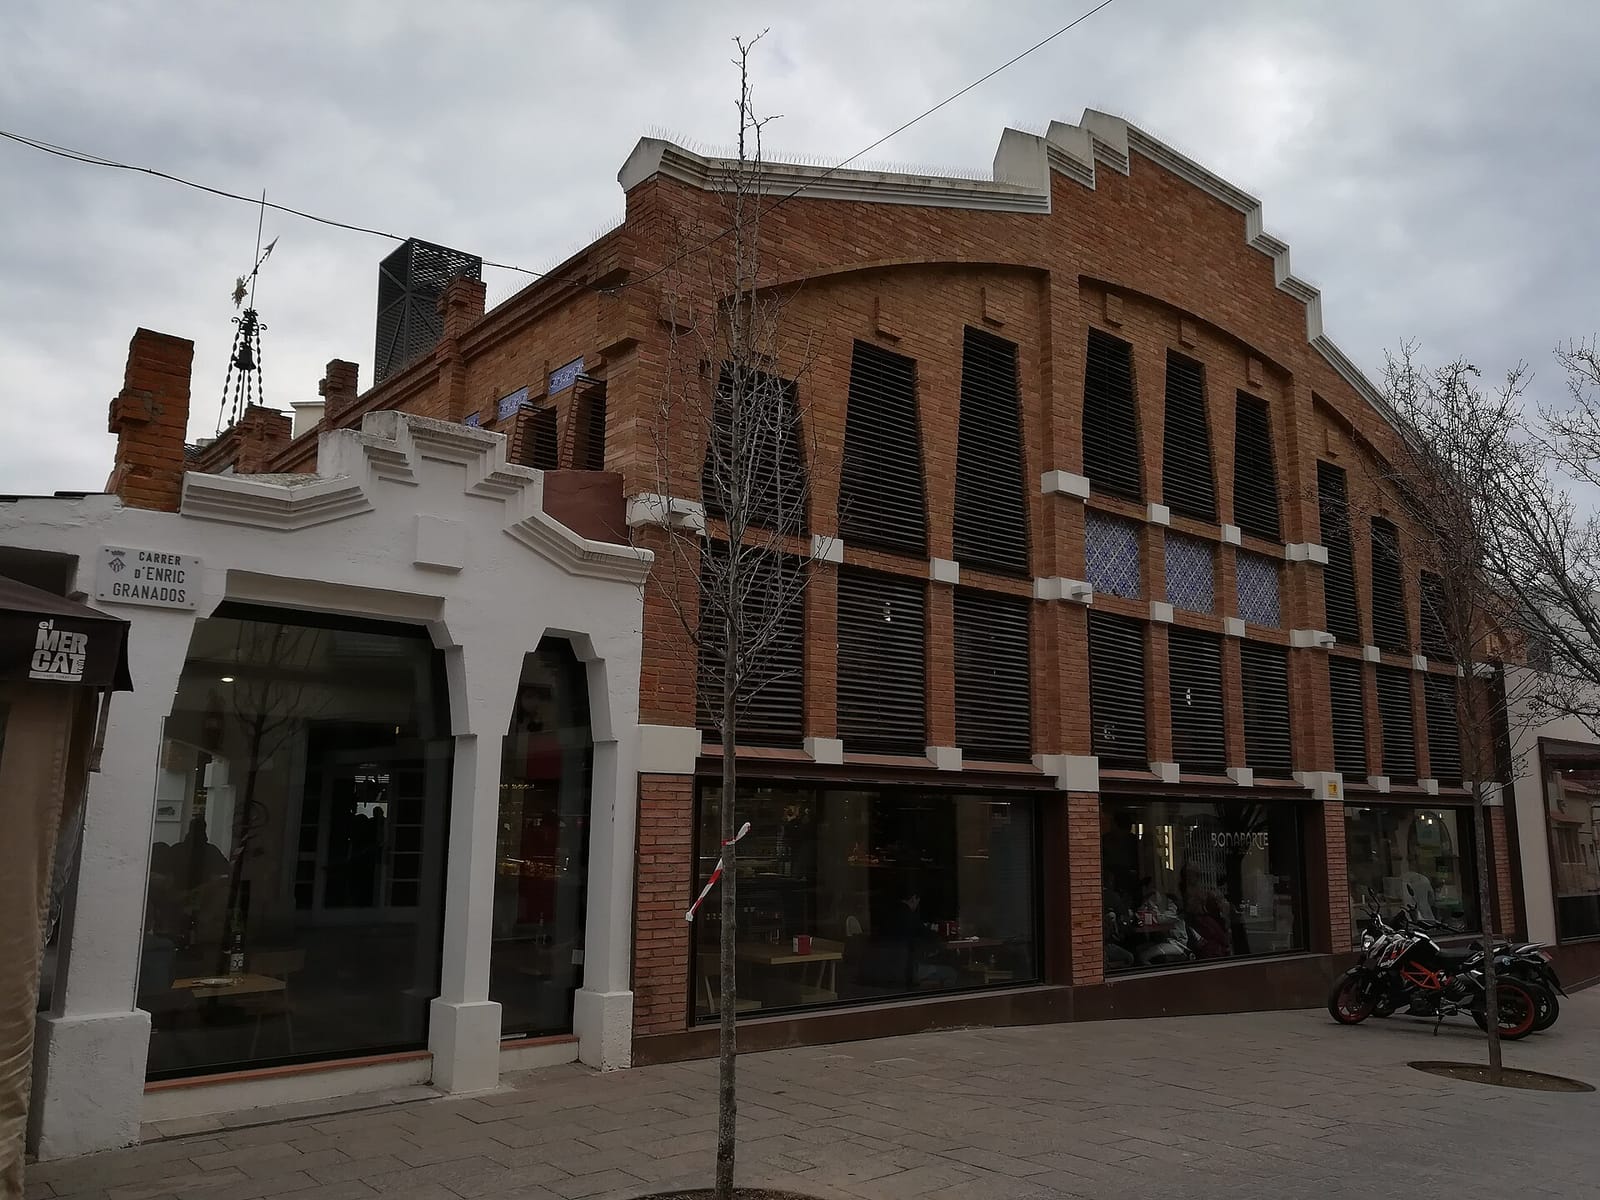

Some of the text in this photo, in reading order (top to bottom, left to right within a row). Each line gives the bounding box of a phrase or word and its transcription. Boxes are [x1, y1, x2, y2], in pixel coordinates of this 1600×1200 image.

[139, 551, 181, 566] CARRER
[113, 582, 186, 603] GRANADOS
[38, 618, 54, 630] el
[34, 629, 88, 655] MER
[31, 650, 86, 674] CAT
[1211, 832, 1269, 850] BONAPARTE
